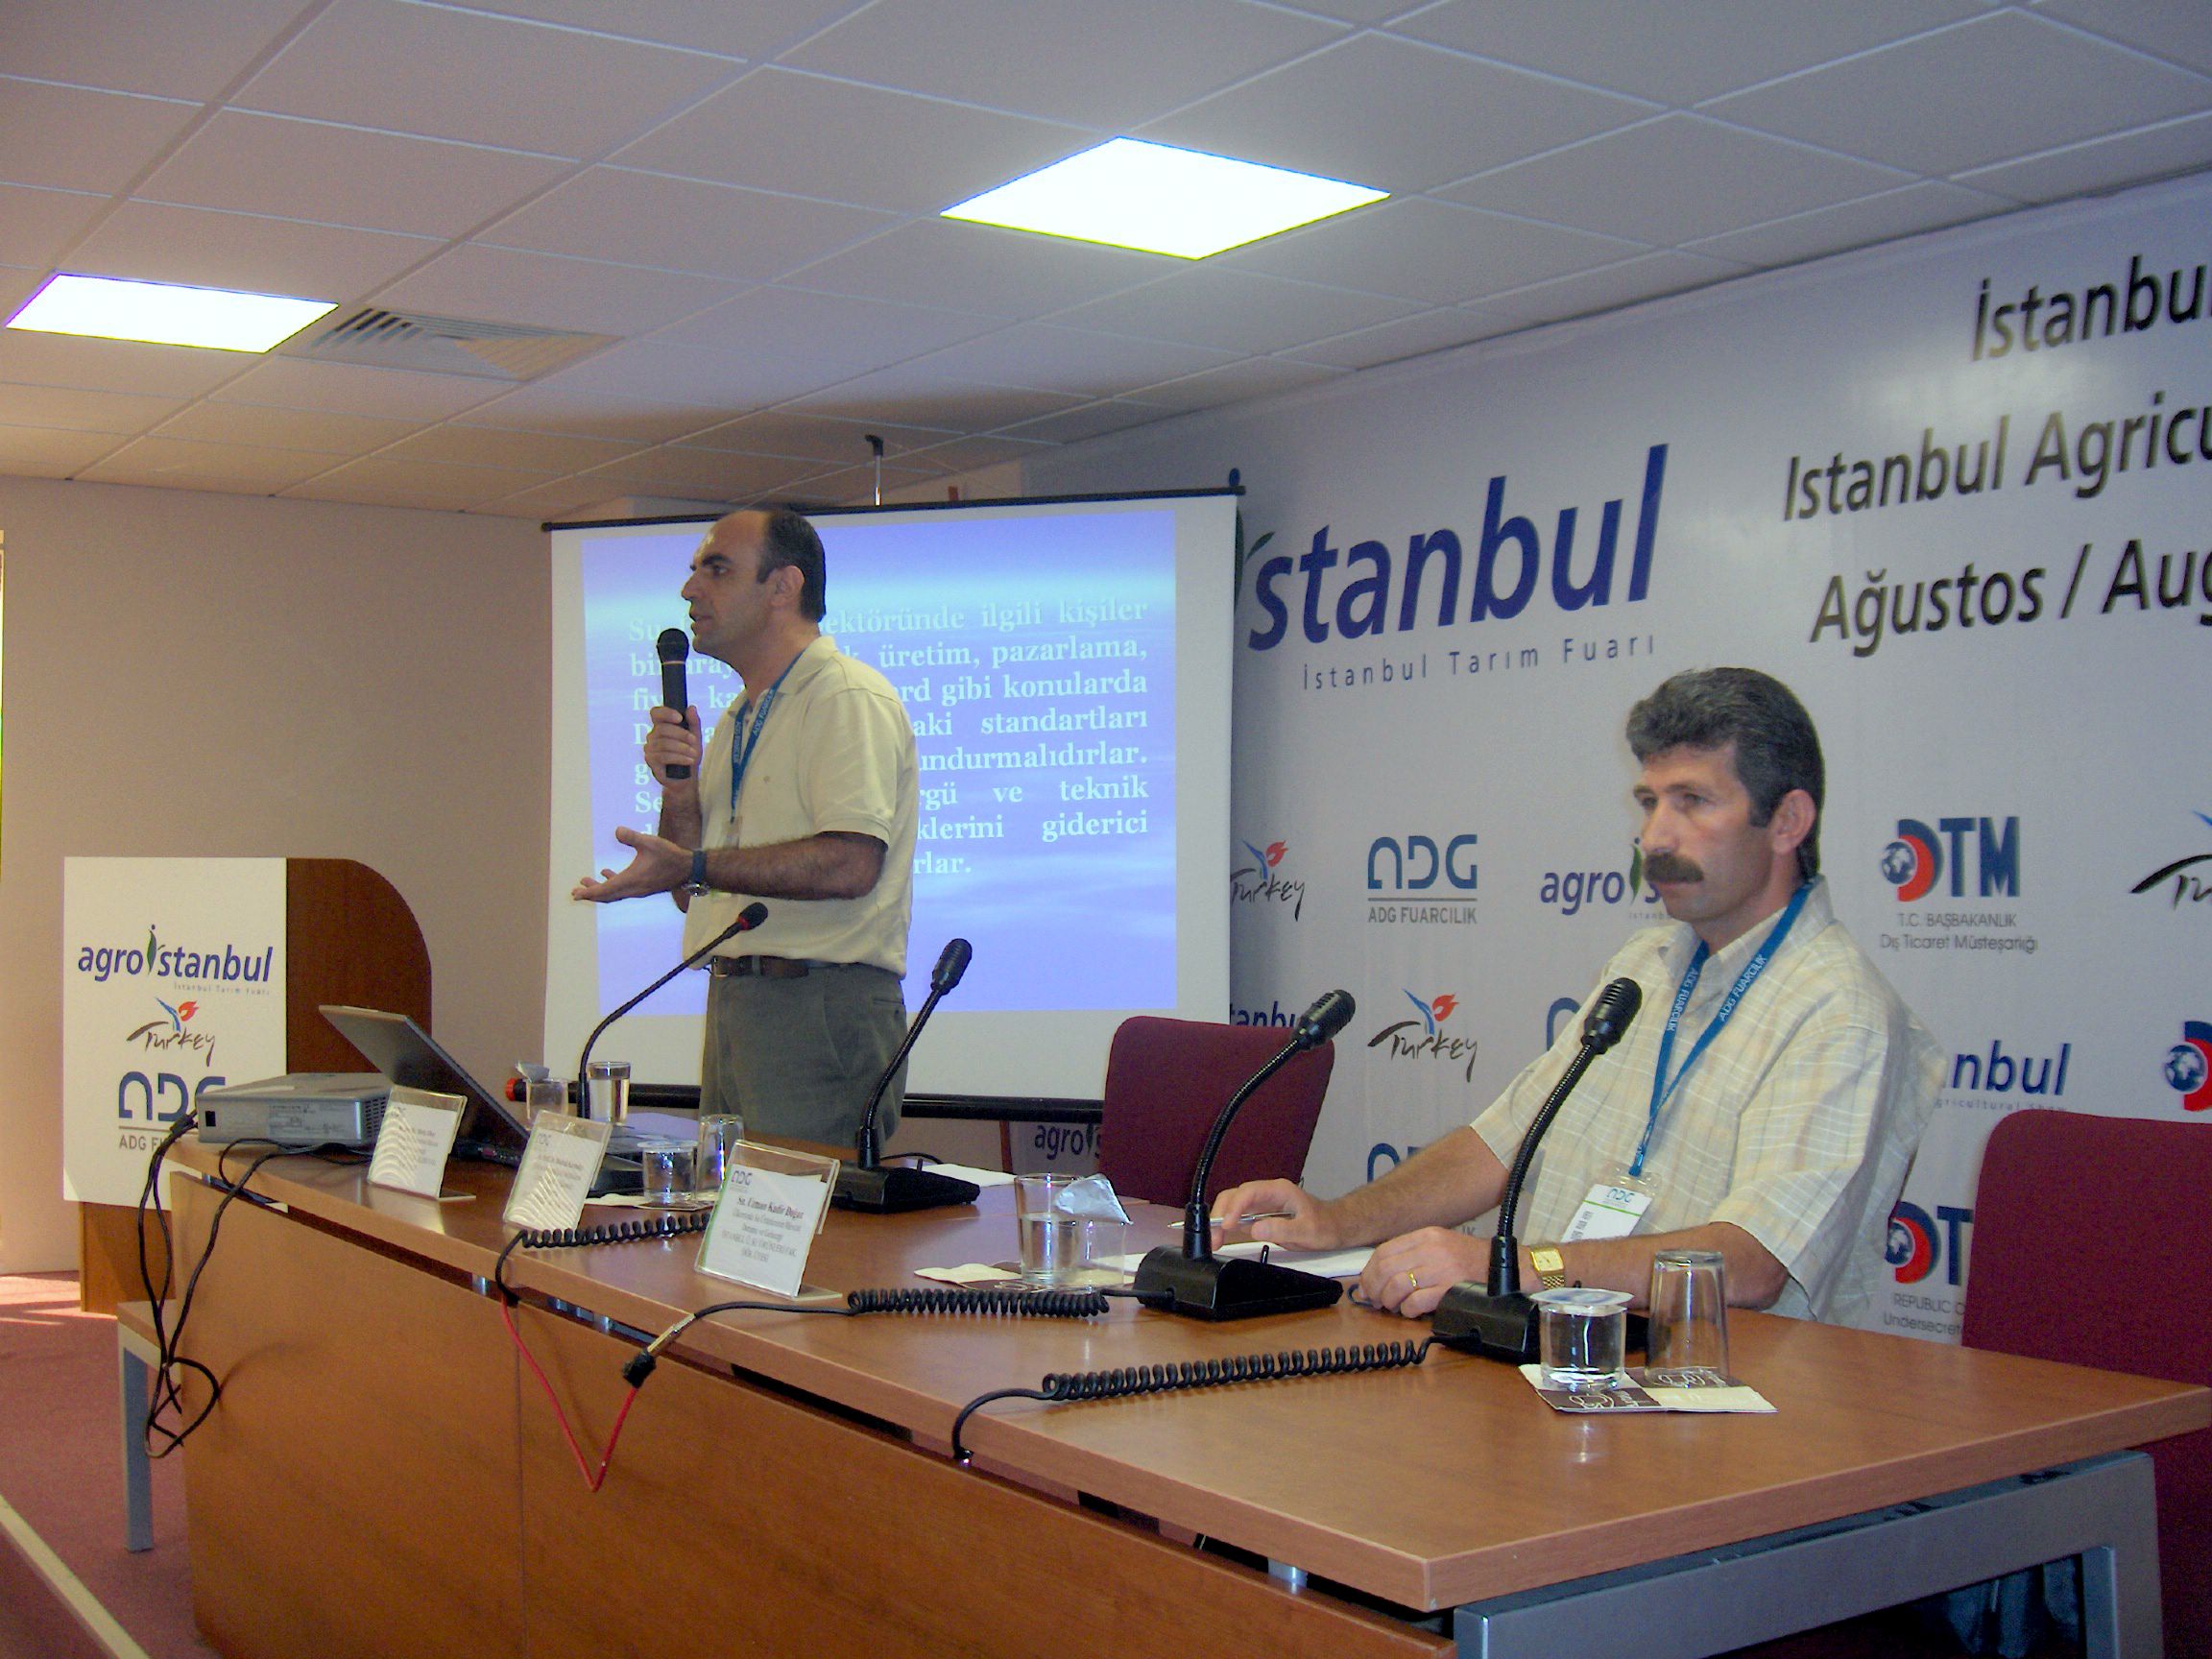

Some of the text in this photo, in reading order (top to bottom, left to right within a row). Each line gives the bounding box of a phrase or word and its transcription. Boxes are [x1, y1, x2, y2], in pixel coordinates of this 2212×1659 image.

[1971, 254, 2212, 363] İstanbu
[1783, 414, 2011, 522] Istanbul
[819, 605, 966, 635] ektöründe
[981, 600, 1043, 633] ilgili
[1059, 596, 1149, 628] kişiler
[1809, 561, 2047, 659] Ağustos
[878, 641, 980, 669] üretim,
[992, 635, 1147, 669] pazarlama,
[1449, 646, 1538, 676] Tarım
[1563, 635, 1655, 664] Fuarı
[942, 675, 992, 707] gibi
[1003, 668, 1147, 699] konularda
[980, 705, 1148, 733] standartları
[993, 784, 1023, 803] ve
[1060, 774, 1149, 801] teknik
[1042, 808, 1148, 843] giderici
[1367, 833, 1479, 890] ADG
[1368, 907, 1478, 925] ADG FUARCILIK
[119, 1135, 147, 1150] ADG
[1892, 1292, 1952, 1314] REPUBLIC
